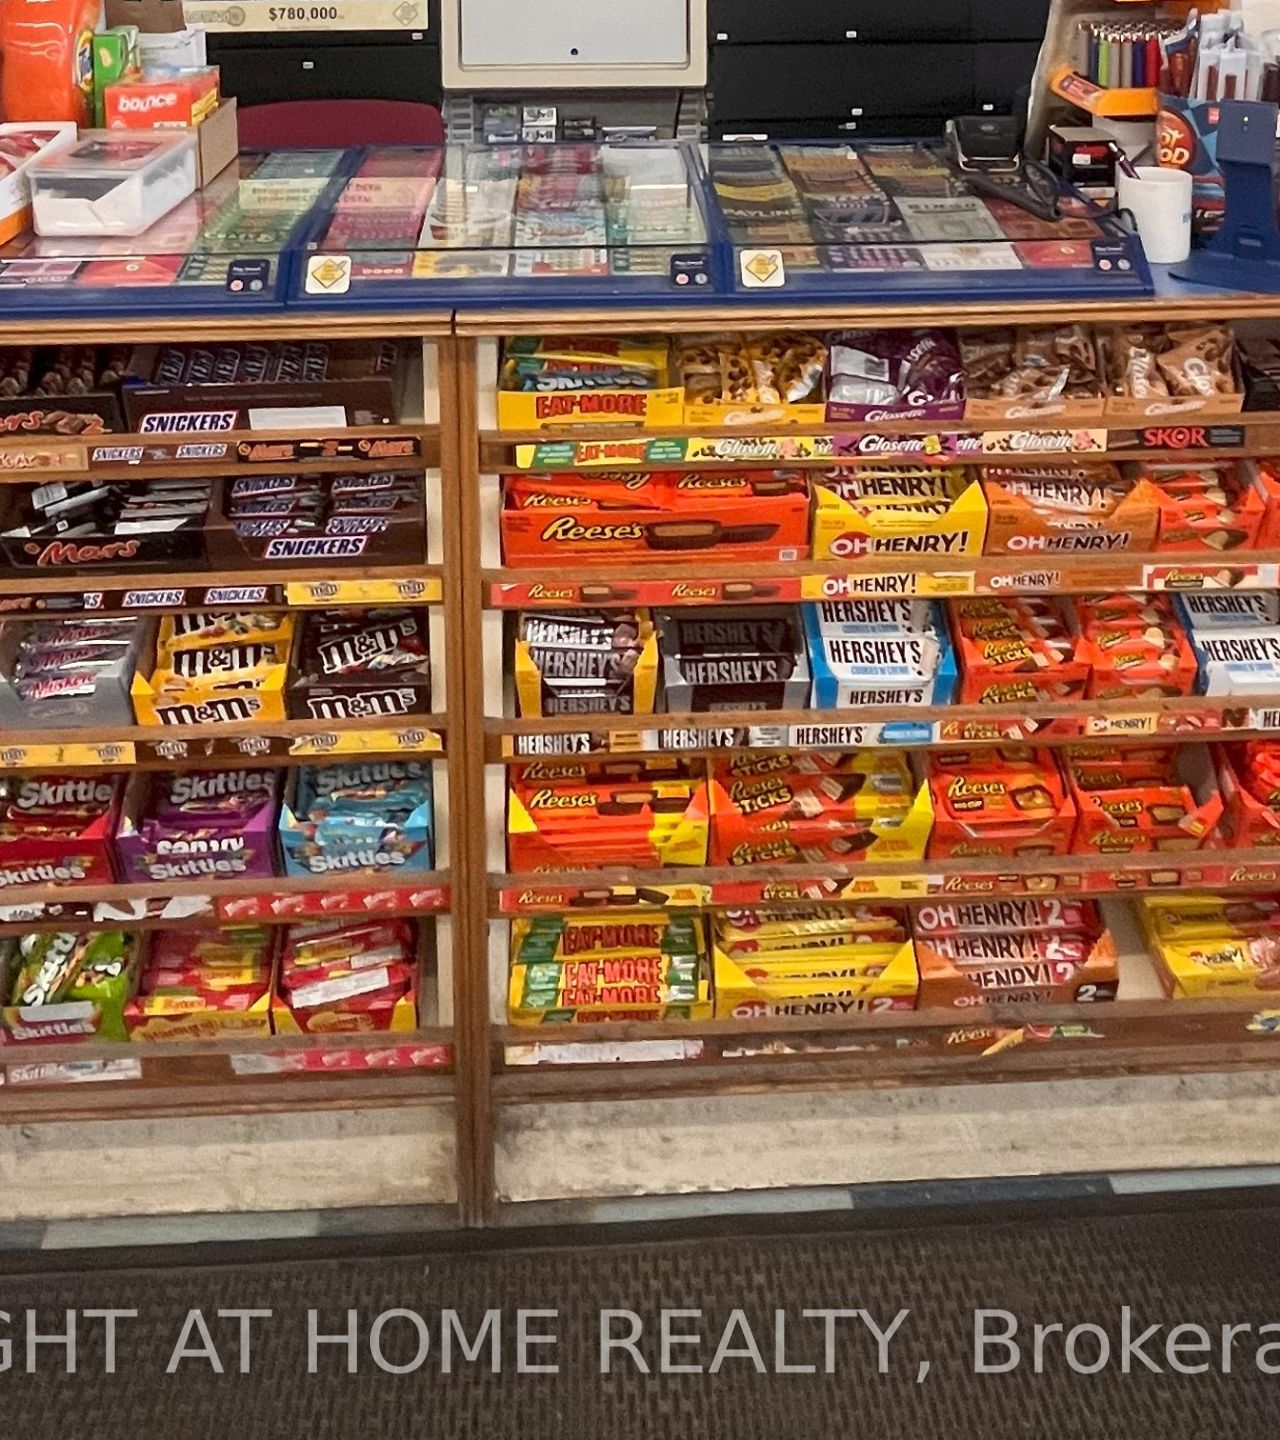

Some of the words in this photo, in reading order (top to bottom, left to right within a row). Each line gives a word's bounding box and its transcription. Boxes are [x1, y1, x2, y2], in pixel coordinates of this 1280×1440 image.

[268, 7, 338, 21] $780,000
[116, 90, 178, 113] bounce
[535, 393, 648, 419] EAT-MORE
[865, 408, 926, 423] Glosette
[142, 410, 238, 433] SNICKERS
[858, 434, 925, 454] Glosette
[1143, 426, 1209, 448] SKOR
[577, 440, 646, 462] EAT-MORE
[542, 516, 644, 542] Reese's
[267, 536, 367, 558] SNICKERS
[830, 537, 872, 557] OH
[874, 532, 968, 554] HENRY!
[1007, 534, 1044, 551] OH
[1045, 531, 1129, 551] HENRY!
[37, 538, 142, 567] Mars
[527, 583, 573, 599] Reese's
[823, 578, 851, 596] OH
[852, 573, 917, 596] HENRY!
[990, 575, 1013, 589] OH
[1013, 571, 1060, 588] HENRY!
[123, 589, 185, 607] SNICKERS
[830, 639, 922, 664] HERSHEY'S
[685, 661, 777, 684] HERSHEY'S
[850, 688, 923, 705] HERSHEY'S
[518, 734, 591, 754] HERSHEY'S
[796, 726, 863, 744] HERSHEY'S
[170, 770, 276, 804] Skittles
[947, 776, 1006, 798] Reese's
[530, 790, 598, 809] Reese's
[733, 790, 793, 814] STICKS
[149, 858, 247, 879] Skittles
[308, 849, 405, 874] Skittles
[918, 903, 957, 931] OH
[958, 899, 1042, 927] HENRY!
[1042, 899, 1065, 925] 2
[565, 957, 662, 988] EAT-MORE
[11, 1020, 96, 1041] Skittles
